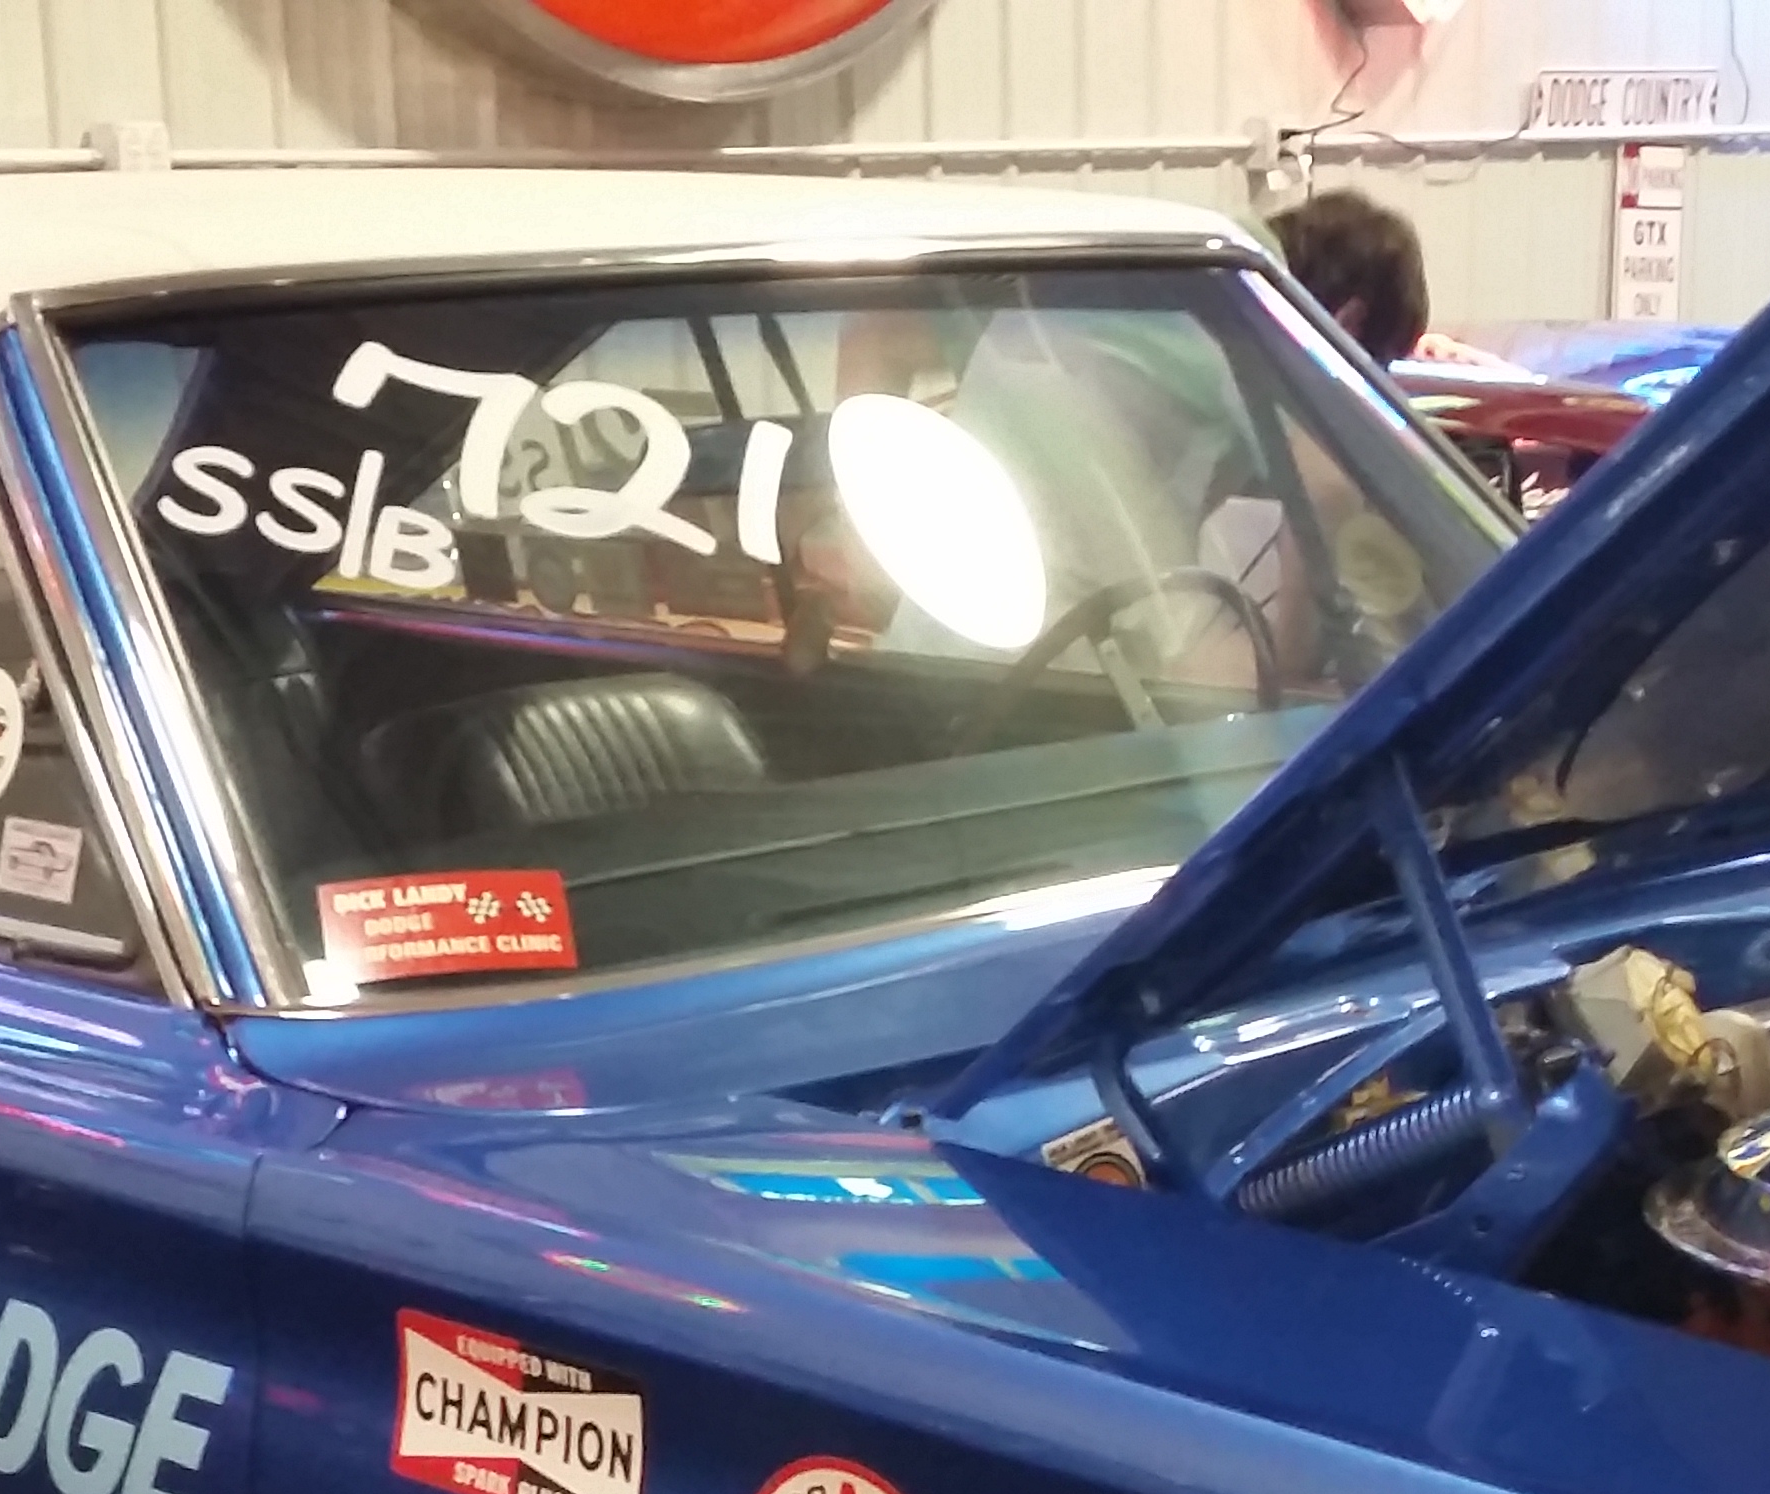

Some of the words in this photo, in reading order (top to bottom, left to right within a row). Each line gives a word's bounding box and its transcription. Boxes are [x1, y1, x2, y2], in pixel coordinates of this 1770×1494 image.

[1547, 77, 1610, 127] DODGE
[1622, 77, 1709, 126] COUNTRY
[1633, 219, 1667, 246] GTX
[333, 340, 792, 565] 721
[157, 444, 458, 590] SS/B
[456, 1334, 543, 1378] EQUIPPED
[544, 1358, 593, 1392] WITH
[414, 1371, 634, 1484] CHAMPION
